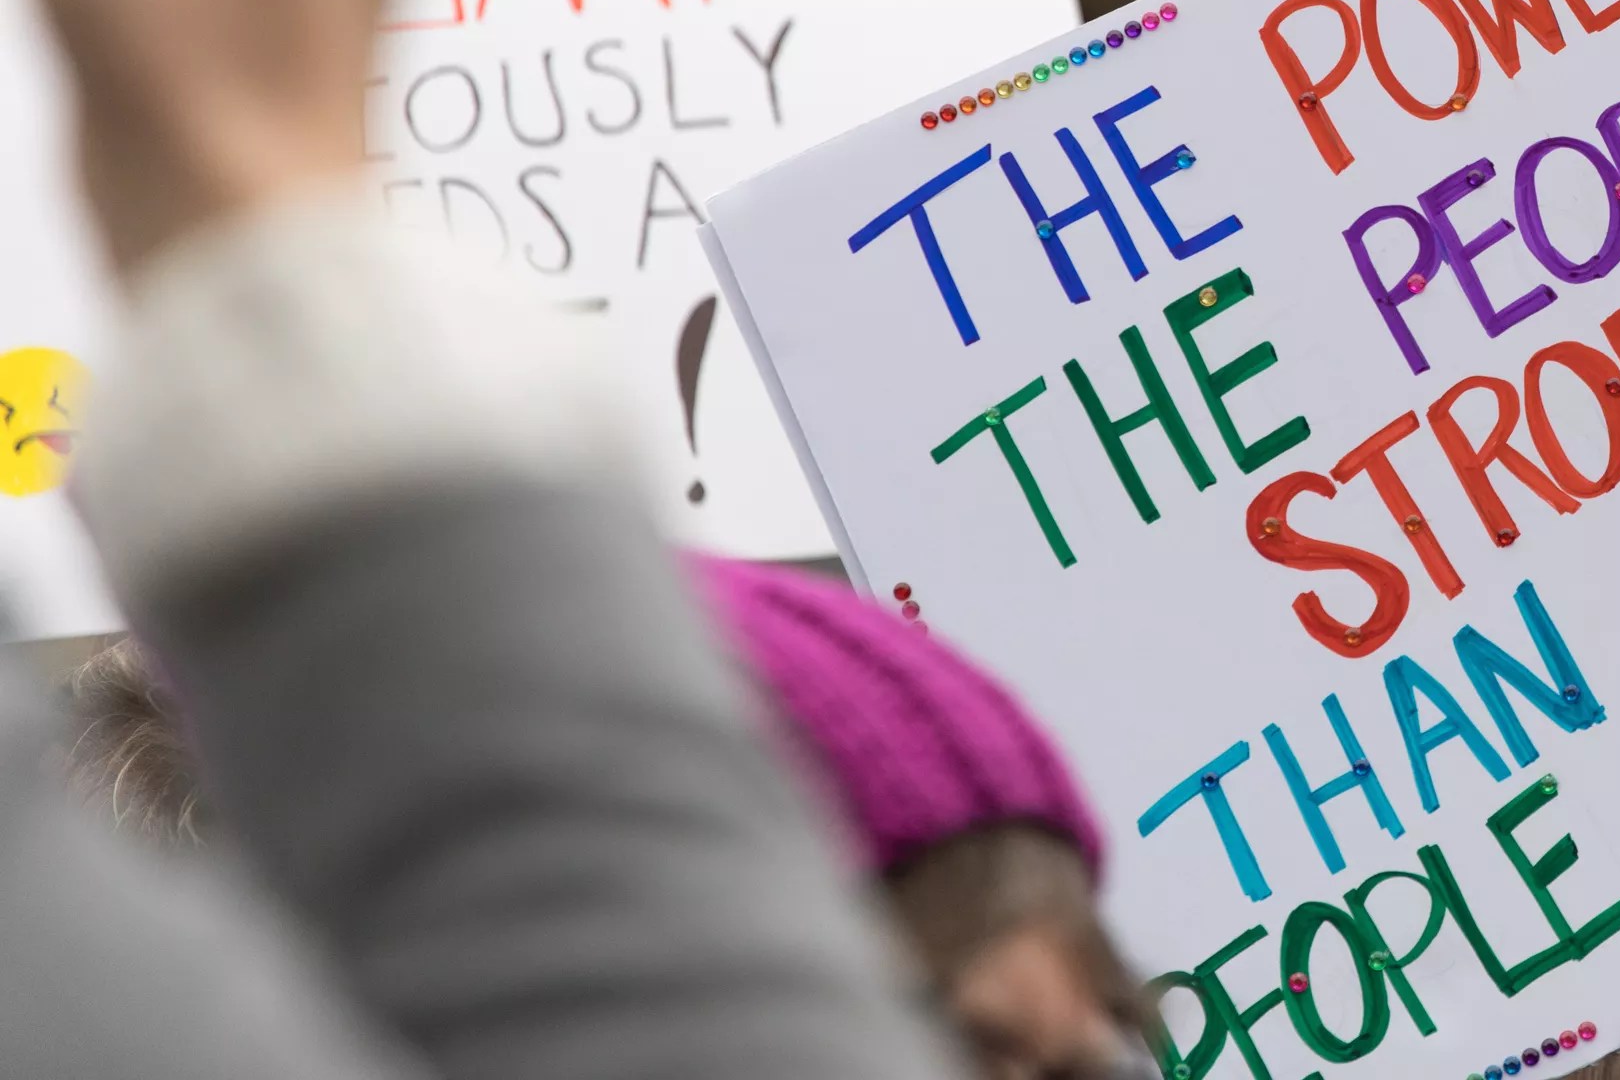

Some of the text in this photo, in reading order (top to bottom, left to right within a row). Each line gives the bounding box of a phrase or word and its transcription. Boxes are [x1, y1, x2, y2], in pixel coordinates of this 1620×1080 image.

[847, 86, 1244, 347] THE
[931, 268, 1311, 568] THE
[1137, 579, 1607, 903] THAN
